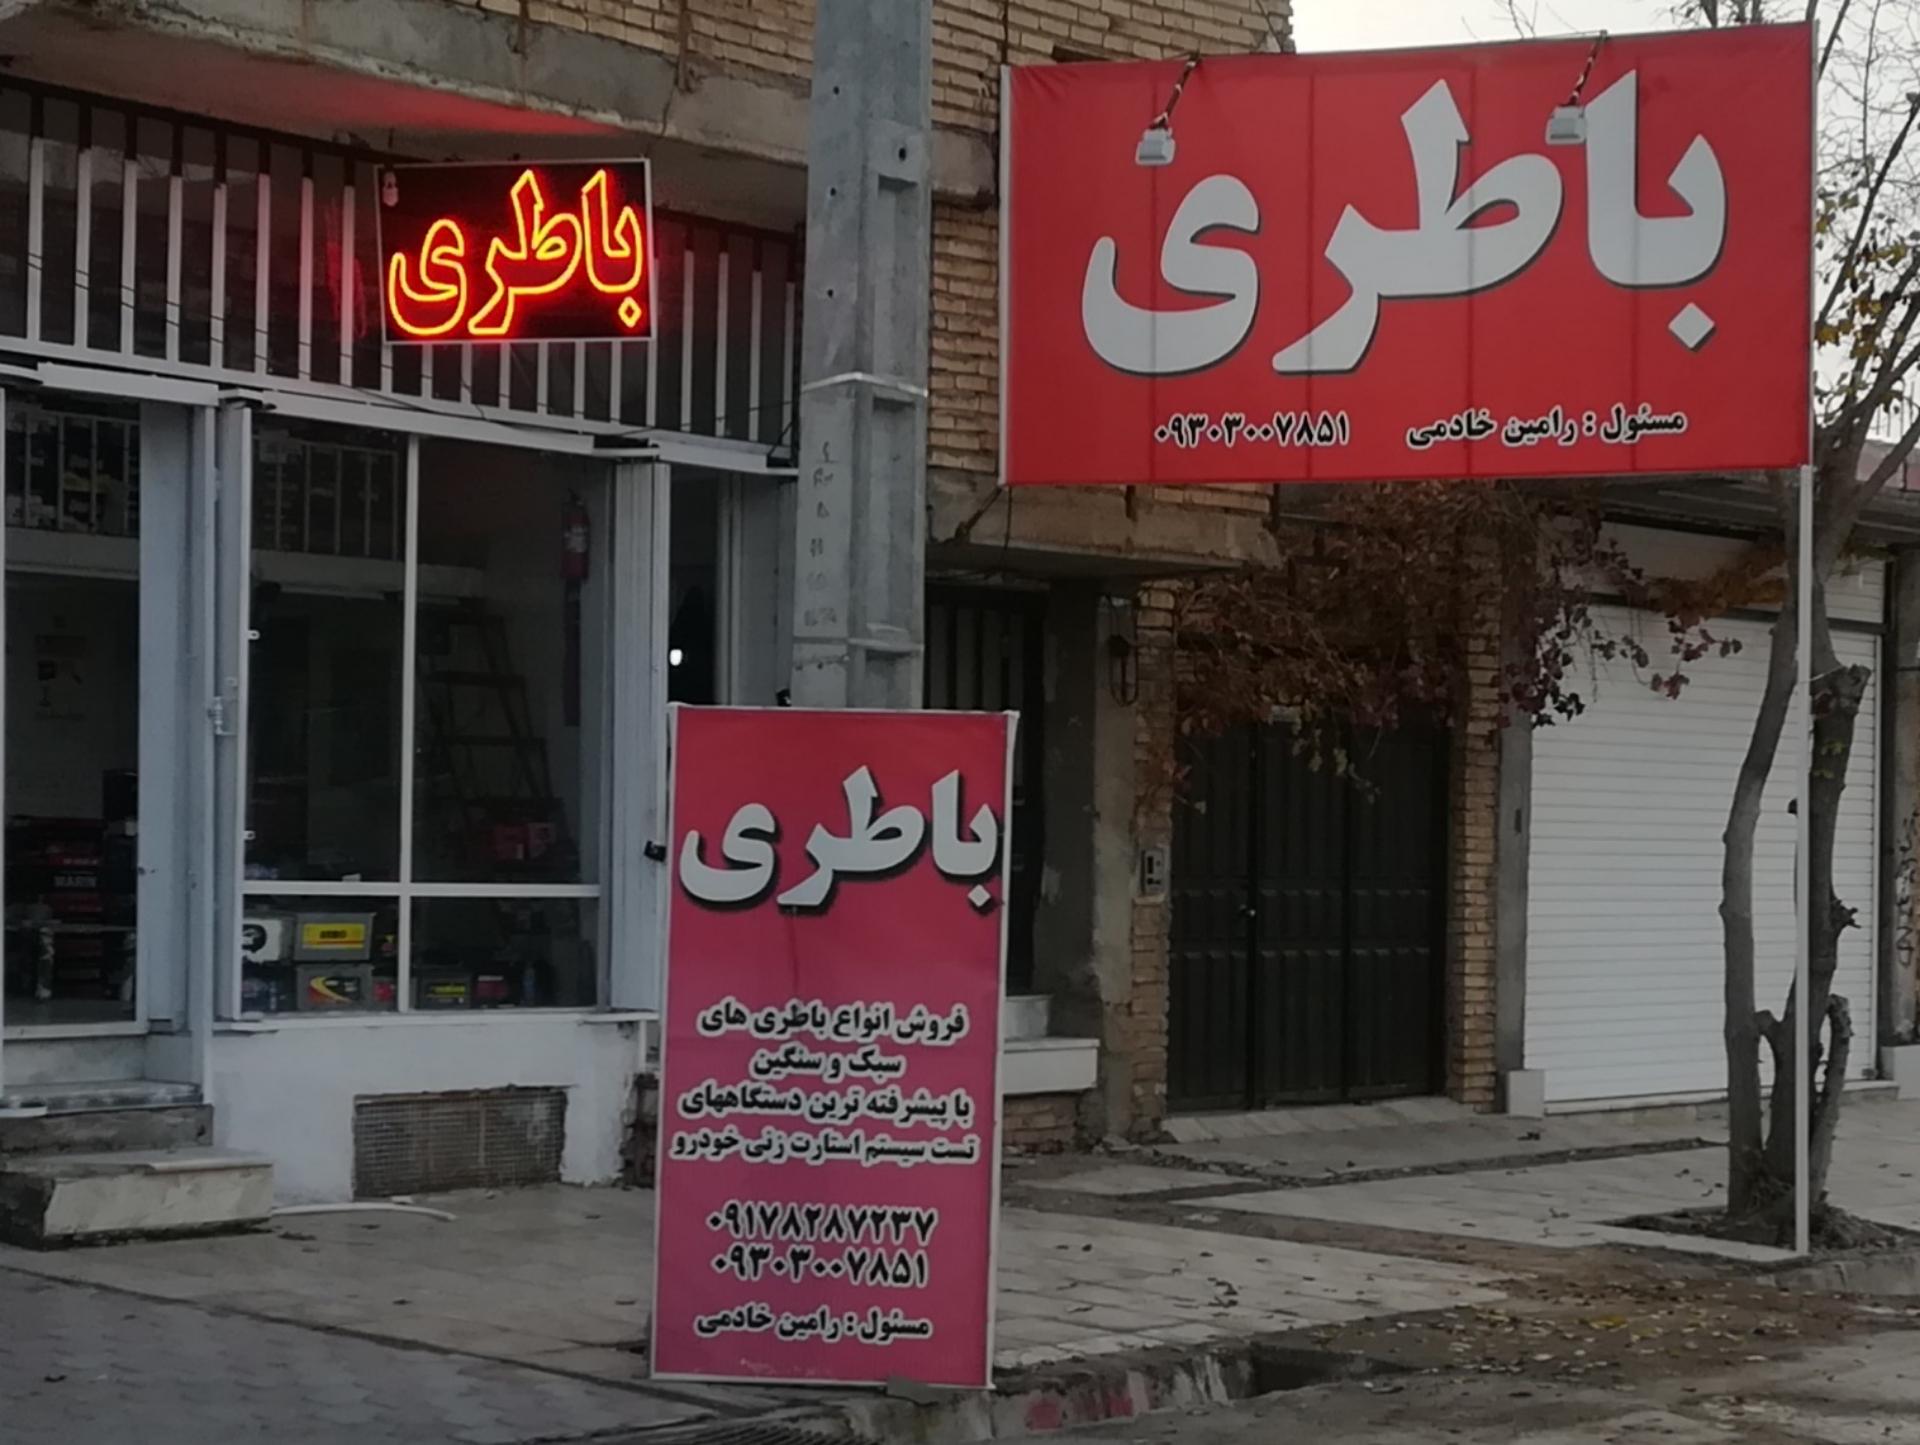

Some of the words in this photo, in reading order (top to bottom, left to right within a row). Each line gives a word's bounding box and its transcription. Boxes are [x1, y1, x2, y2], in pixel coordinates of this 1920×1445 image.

[1082, 68, 1728, 374] باطری
[387, 168, 643, 336] باطری
[1155, 410, 1350, 448] ۰۹۳۰۳۰۰۷۸۵۱
[1406, 408, 1496, 449] خادمی
[1503, 405, 1578, 446] رامین
[679, 764, 1001, 910] باطری
[699, 996, 748, 1037] های
[752, 997, 829, 1038] باطری
[831, 1001, 892, 1038] انواع
[895, 1002, 968, 1038] فروش
[752, 1042, 823, 1078] سنگین
[828, 1051, 843, 1080] و
[847, 1045, 904, 1083] سبک
[680, 1080, 803, 1118] دستگاههای
[807, 1085, 861, 1123] ترین
[865, 1086, 949, 1128] پیشرفته
[952, 1088, 974, 1128] با
[671, 1125, 741, 1158] خودرو
[744, 1125, 785, 1158] زنی
[789, 1130, 861, 1165] استارت
[865, 1136, 926, 1166] سیستم
[929, 1135, 979, 1163] تست
[707, 1199, 939, 1246] ۰۹۱۷۸۲۸۷۲۳۷
[712, 1241, 928, 1287] ۰۹۳۰۳۰۰۷۸۵۱
[696, 1302, 773, 1336] خادمی
[777, 1304, 840, 1342] رامین
